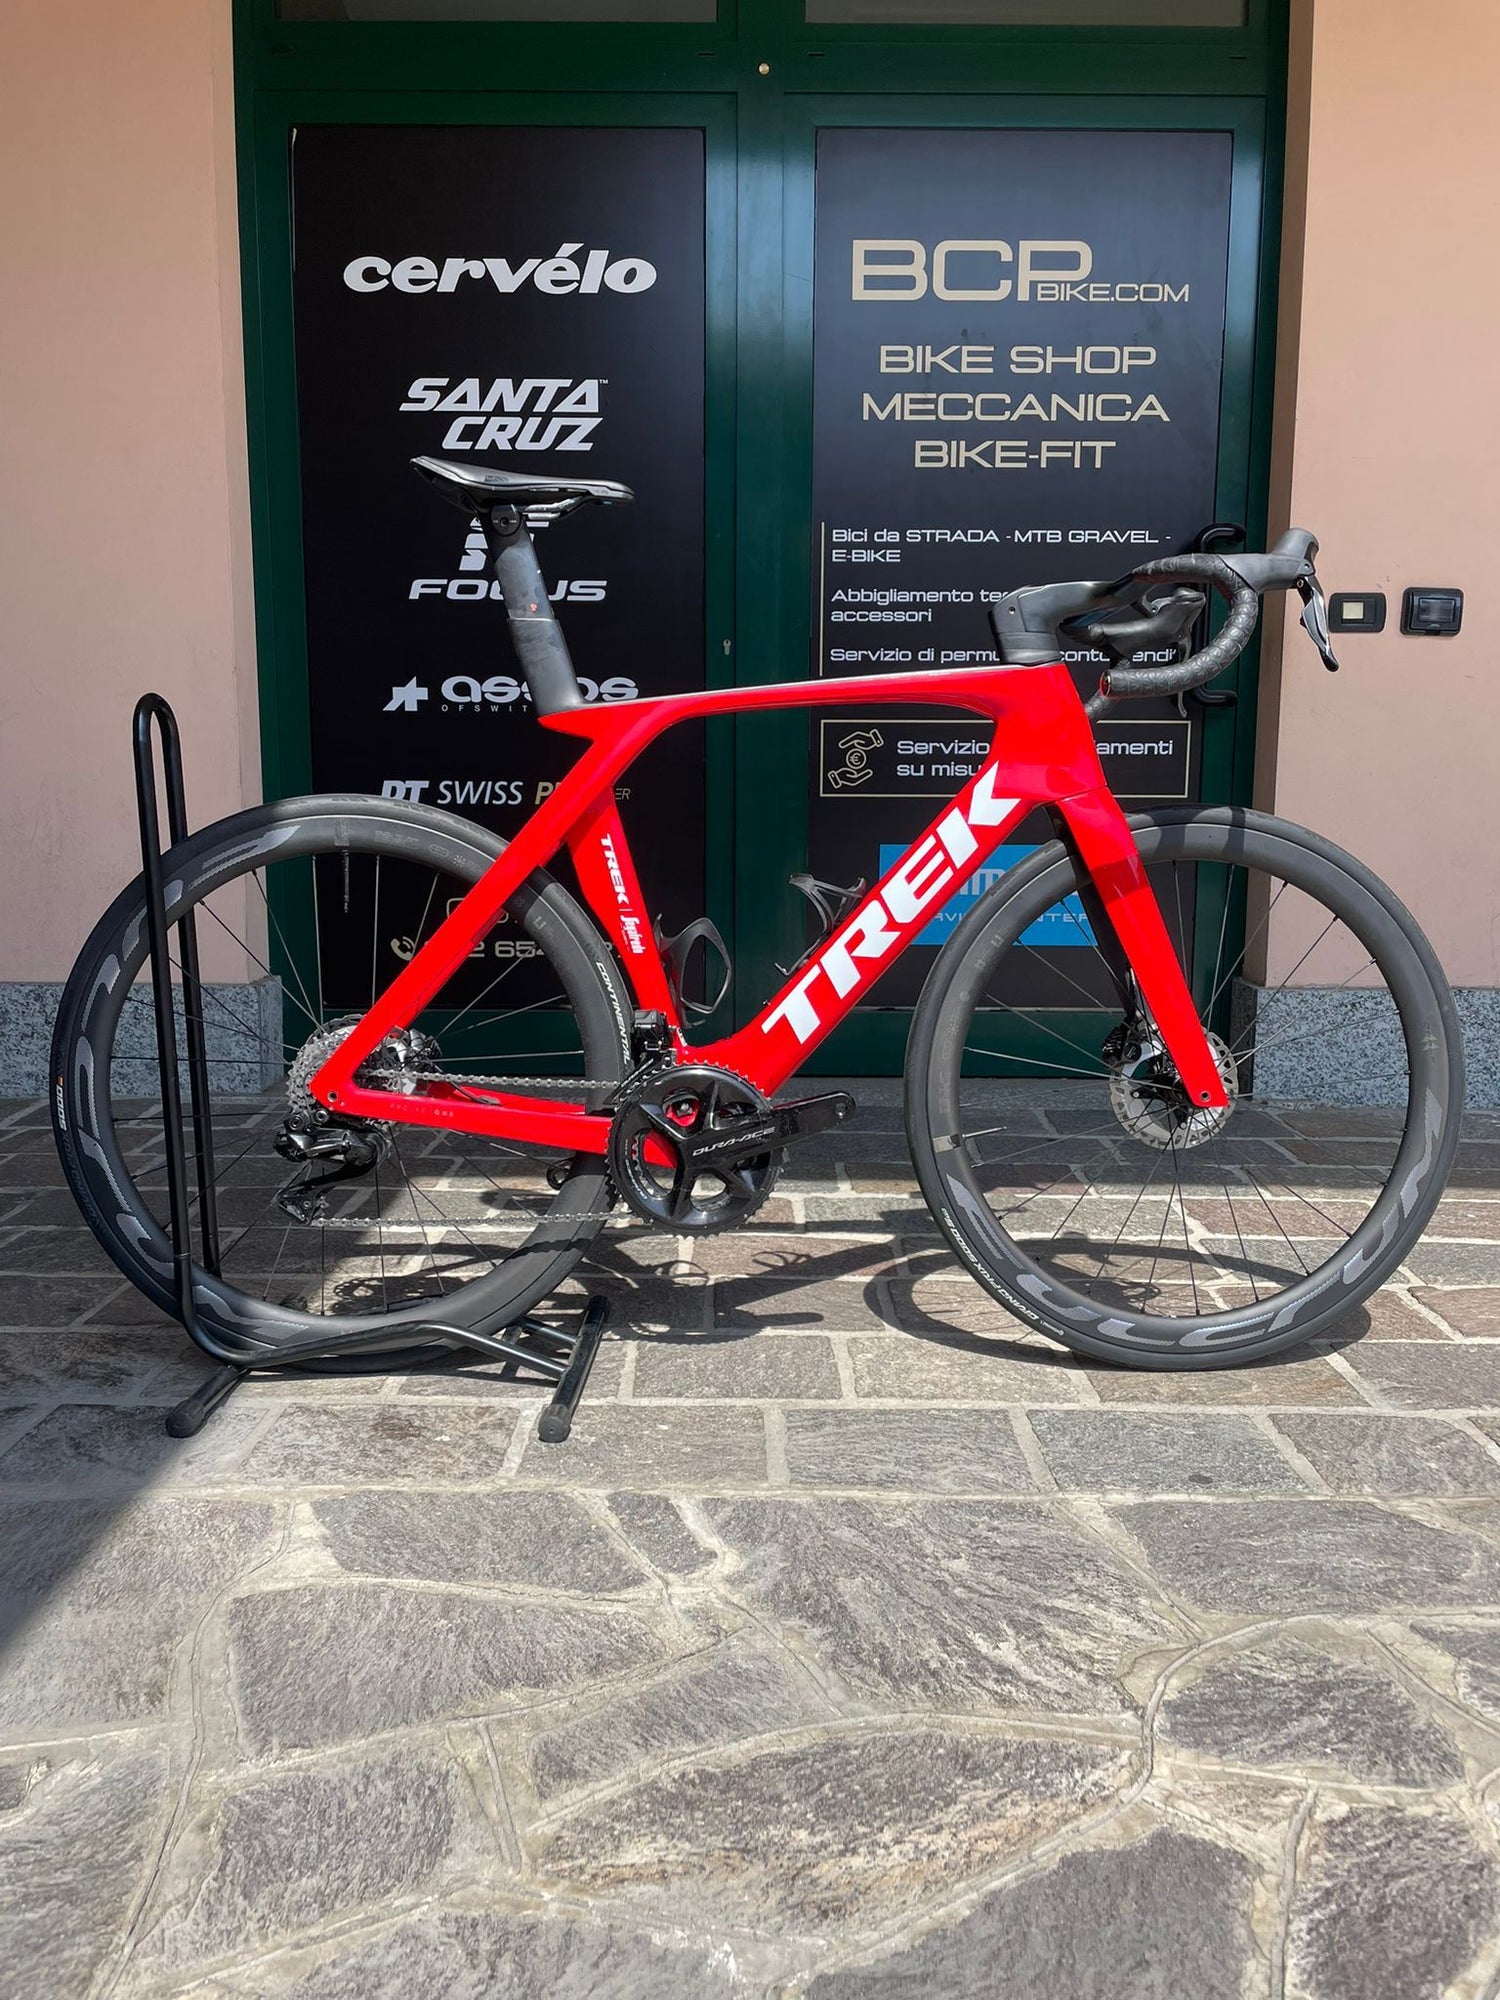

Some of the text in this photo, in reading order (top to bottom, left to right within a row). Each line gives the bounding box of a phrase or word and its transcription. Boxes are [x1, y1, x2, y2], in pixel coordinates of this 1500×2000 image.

[343, 243, 657, 294] cervélo
[852, 240, 1190, 302] BCP BIKE.COM
[880, 345, 1156, 374] BIKE SHOP
[399, 378, 599, 412] SANTA
[862, 393, 1170, 422] MECCANICA
[442, 416, 603, 450] CRUZ
[914, 440, 1116, 469] BIKE-FIT
[832, 528, 868, 543] Bici
[874, 529, 899, 543] da
[905, 530, 1000, 543] STRADA
[1068, 530, 1159, 544] GRAVEL
[832, 549, 901, 563] E-BIKE
[831, 588, 974, 606] Abbigliamento
[830, 608, 932, 622] accessori
[830, 647, 912, 662] Servizio
[918, 647, 934, 662] di
[897, 739, 990, 755] Servizio
[897, 761, 982, 776] su misu
[437, 780, 524, 805] SWISS
[601, 833, 629, 904] TREK
[761, 760, 1021, 1044] TREK
[596, 961, 630, 1065] CONTINENTAL
[56, 1084, 67, 1131] 5000
[692, 1126, 776, 1157] DURA-ACE
[950, 1227, 978, 1263] 5000
[974, 1262, 1001, 1289] PRIX
[998, 1288, 1040, 1320] GRAND
